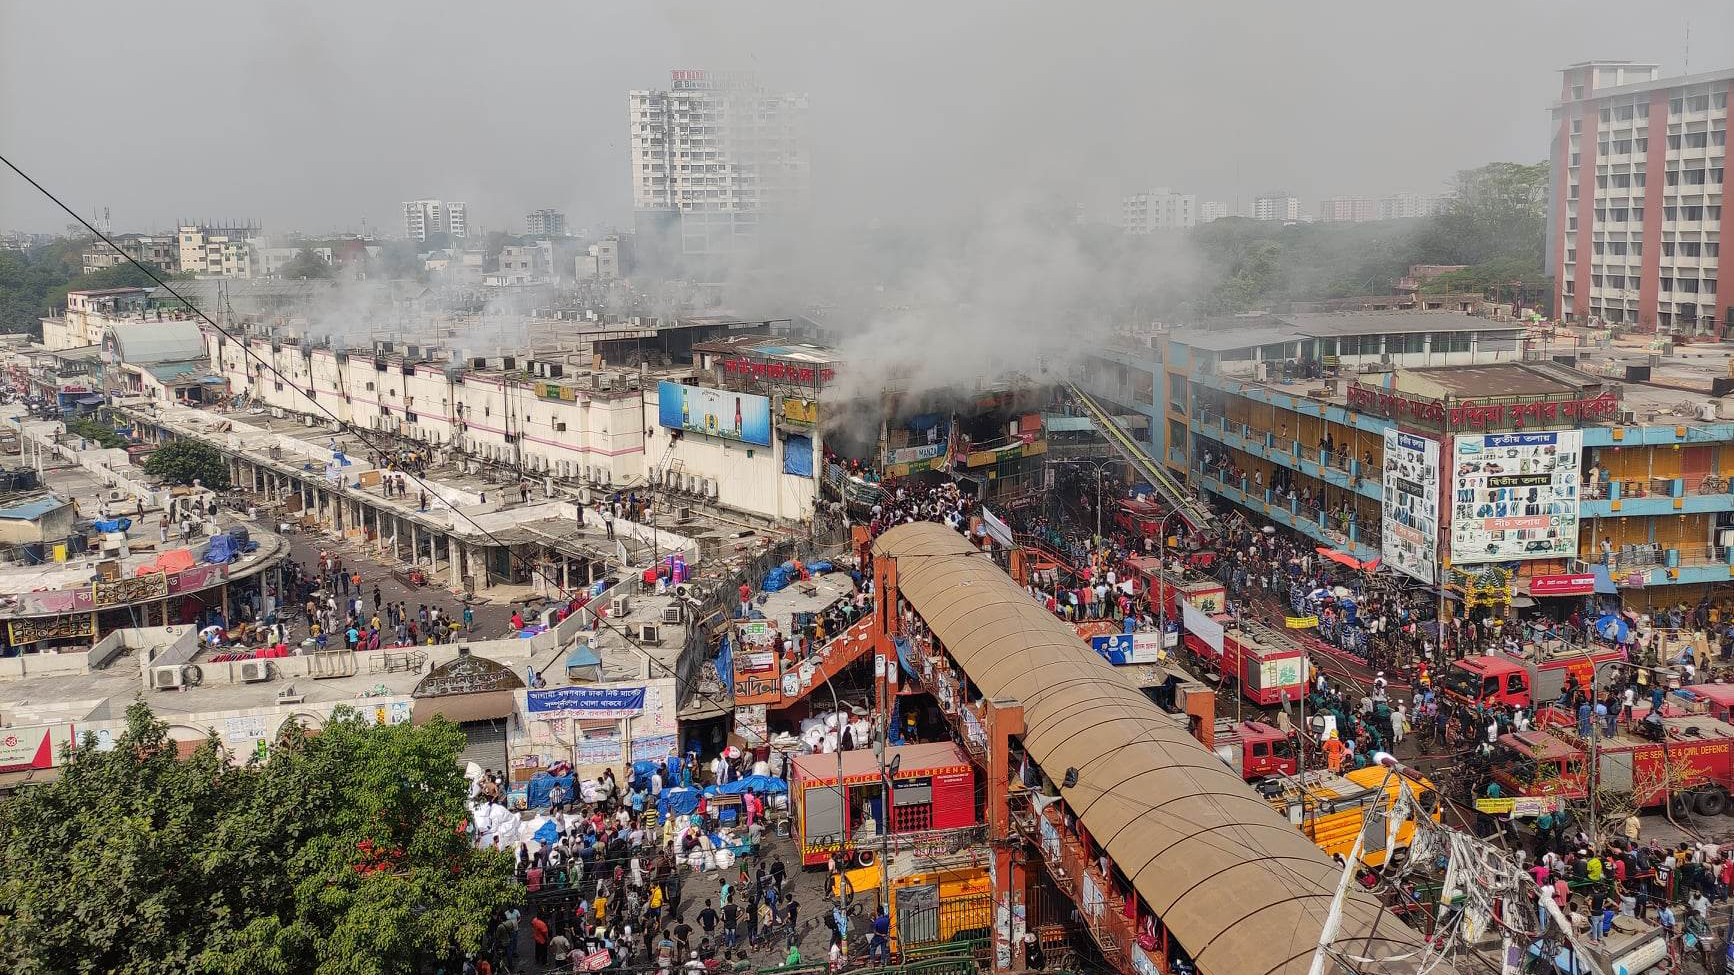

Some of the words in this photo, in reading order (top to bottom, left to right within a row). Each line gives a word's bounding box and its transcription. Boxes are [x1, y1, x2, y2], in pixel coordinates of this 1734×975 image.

[1449, 401, 1503, 426] চন্দ্রিমা
[1509, 403, 1556, 426] সুপার
[1563, 392, 1617, 418] মার্কেট
[1492, 435, 1520, 447] তৃতীয়
[1523, 433, 1550, 443] তলায়
[1489, 477, 1517, 487] দ্বিতীয়
[1521, 474, 1547, 484] তলায়
[1514, 516, 1541, 526] তলায়
[735, 676, 778, 698] মদিনা
[529, 691, 555, 700] আগামী
[605, 689, 619, 697] নিউ
[620, 689, 642, 697] মার্কেট
[580, 700, 599, 708] খোলা
[1633, 751, 1649, 762] FIRE
[1683, 746, 1698, 757] CIVIL
[1699, 744, 1728, 756] DEFENCE
[831, 775, 877, 785] SRVICE
[924, 765, 972, 776] DEFENCE
[1659, 871, 1668, 880] 10
